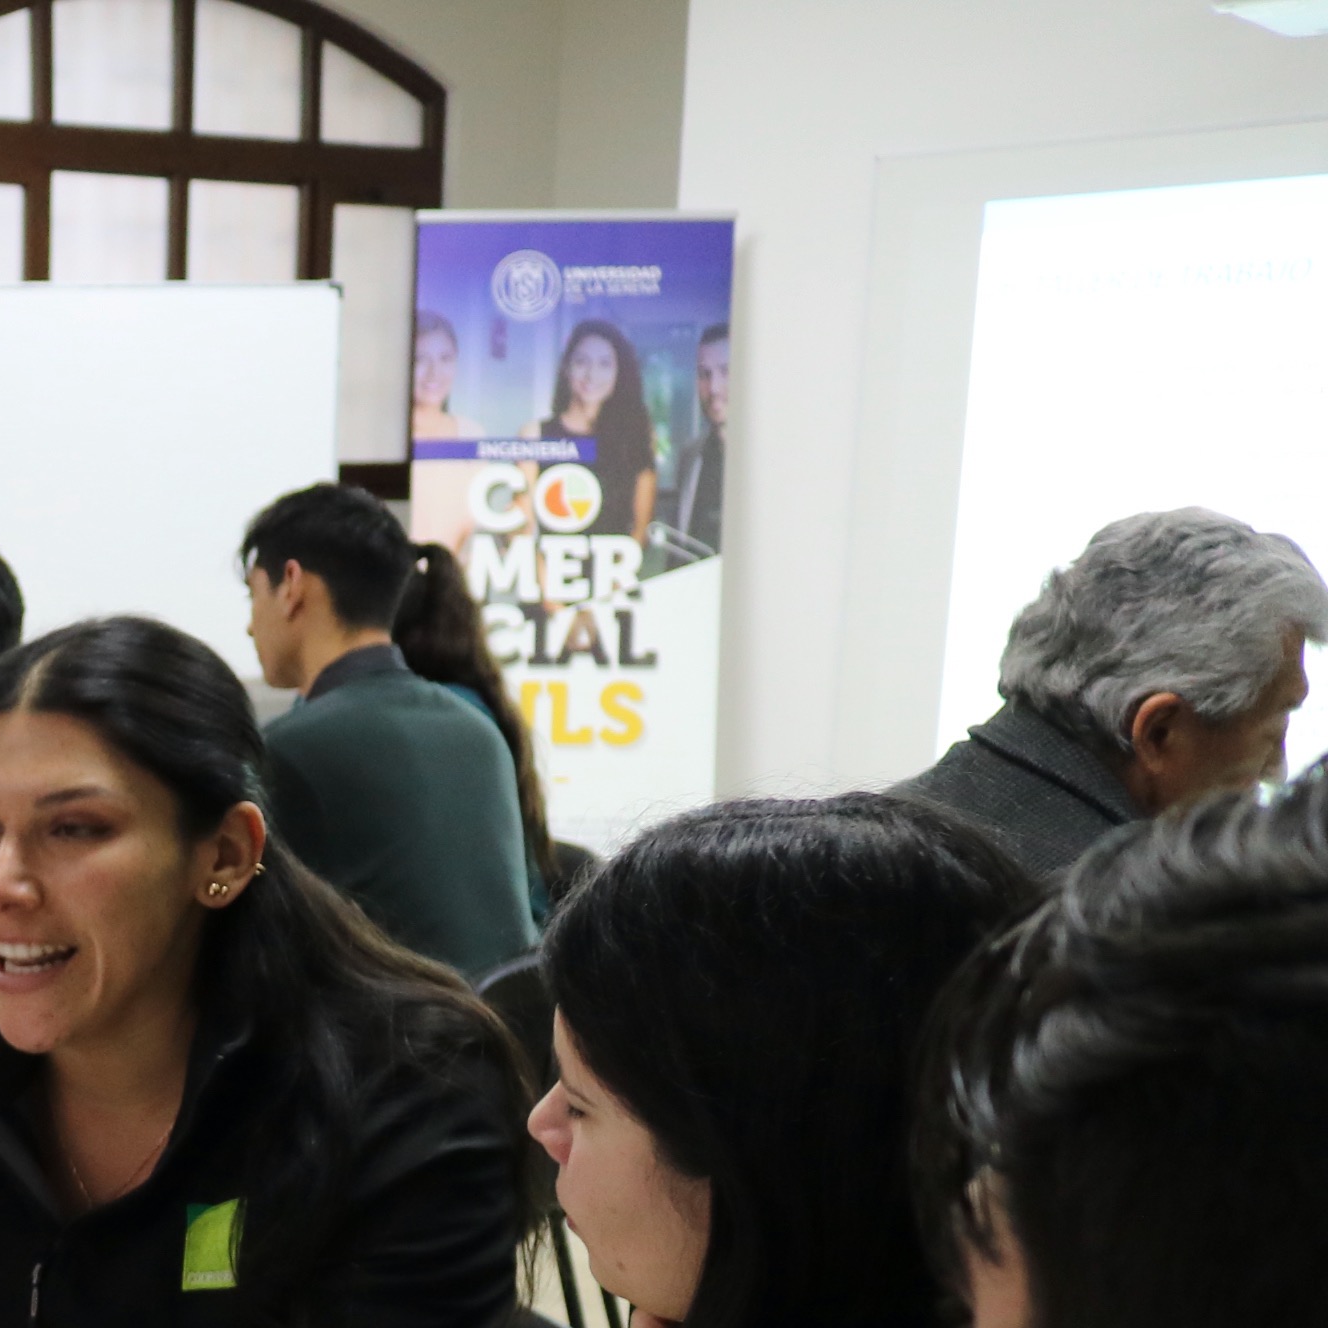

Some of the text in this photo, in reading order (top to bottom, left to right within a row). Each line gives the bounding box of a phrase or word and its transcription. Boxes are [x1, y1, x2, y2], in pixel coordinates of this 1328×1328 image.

[564, 265, 662, 280] UNIVERSIDAD
[606, 281, 661, 295] SERENA
[477, 439, 580, 459] INGENIERÍA
[468, 533, 644, 602] MER
[481, 602, 658, 668] CIAL
